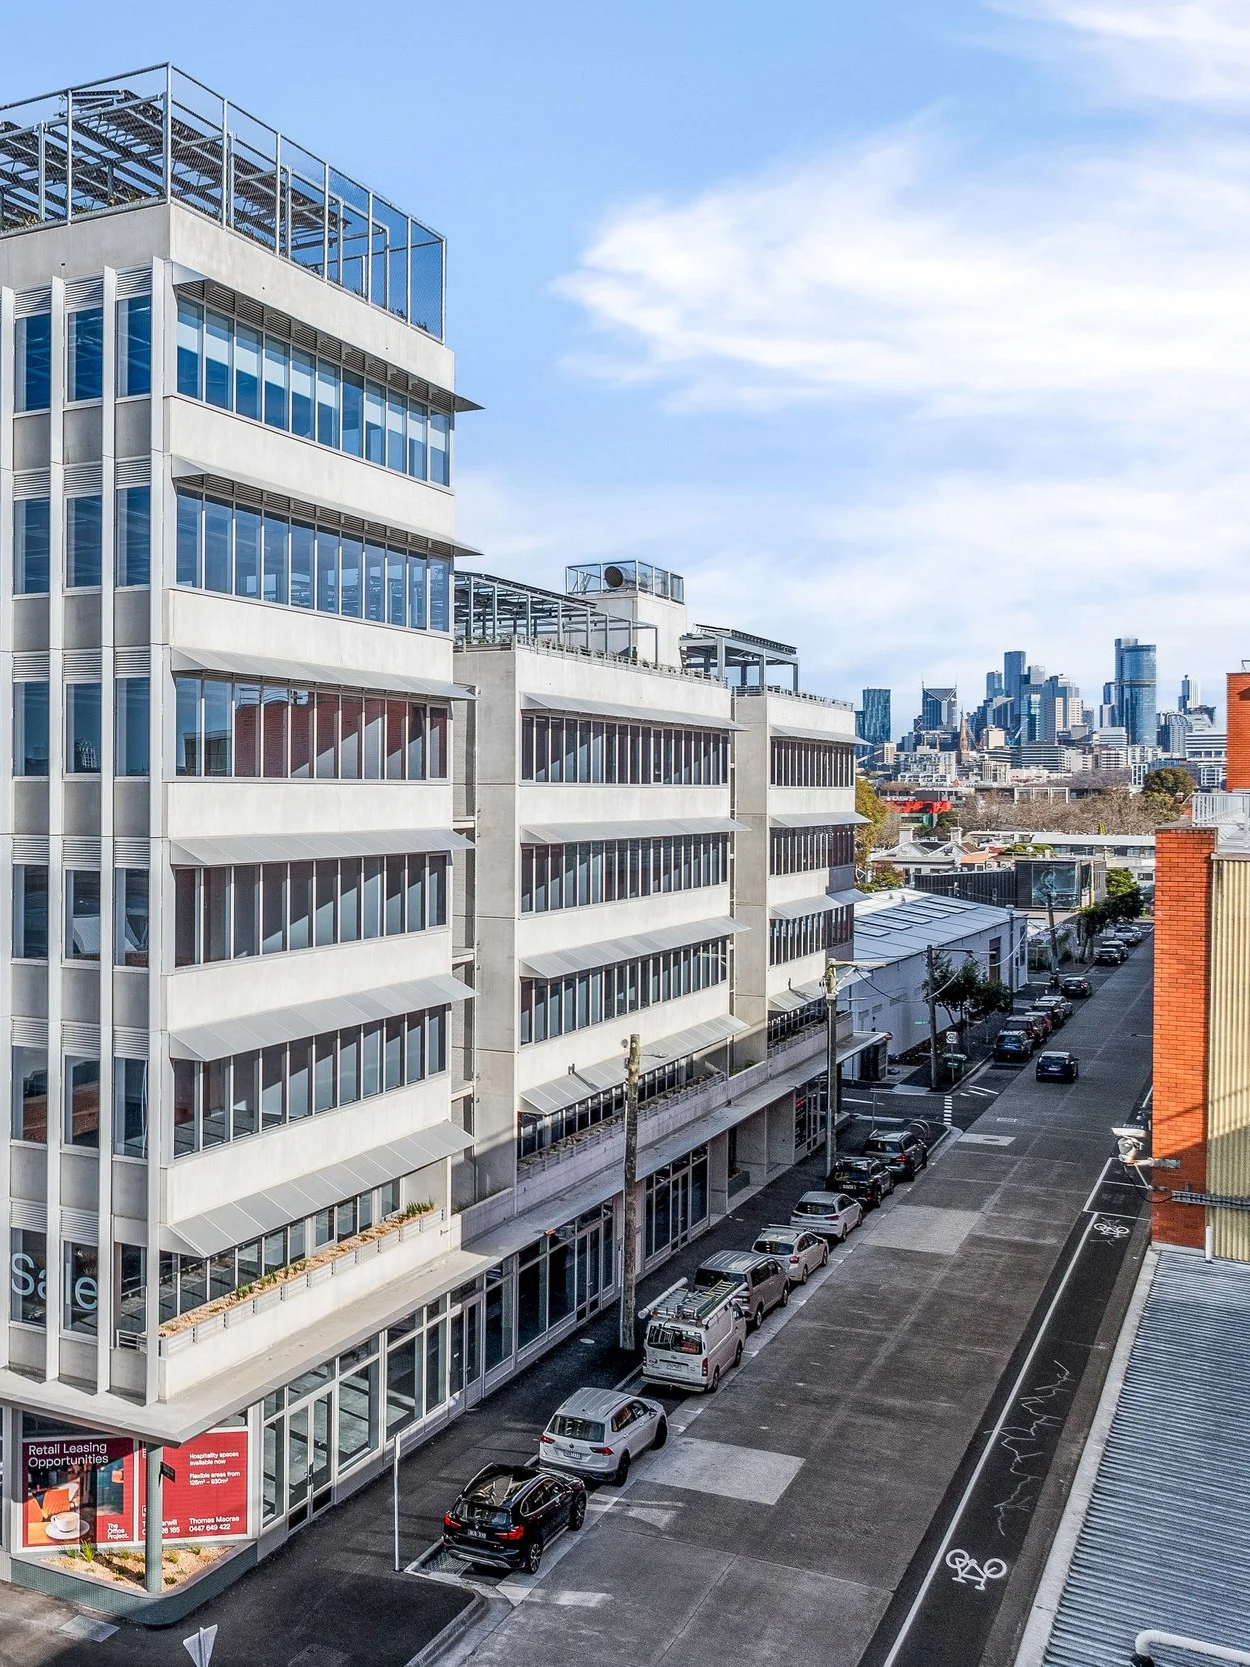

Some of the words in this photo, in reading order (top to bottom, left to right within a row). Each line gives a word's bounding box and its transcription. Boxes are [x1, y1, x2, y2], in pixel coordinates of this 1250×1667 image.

[28, 1444, 60, 1456] Retail
[63, 1442, 107, 1454] Leasing
[190, 1452, 218, 1460] Hospitality
[219, 1451, 239, 1459] spaces
[28, 1454, 109, 1469] Opportunities
[189, 1517, 215, 1525] Thomas
